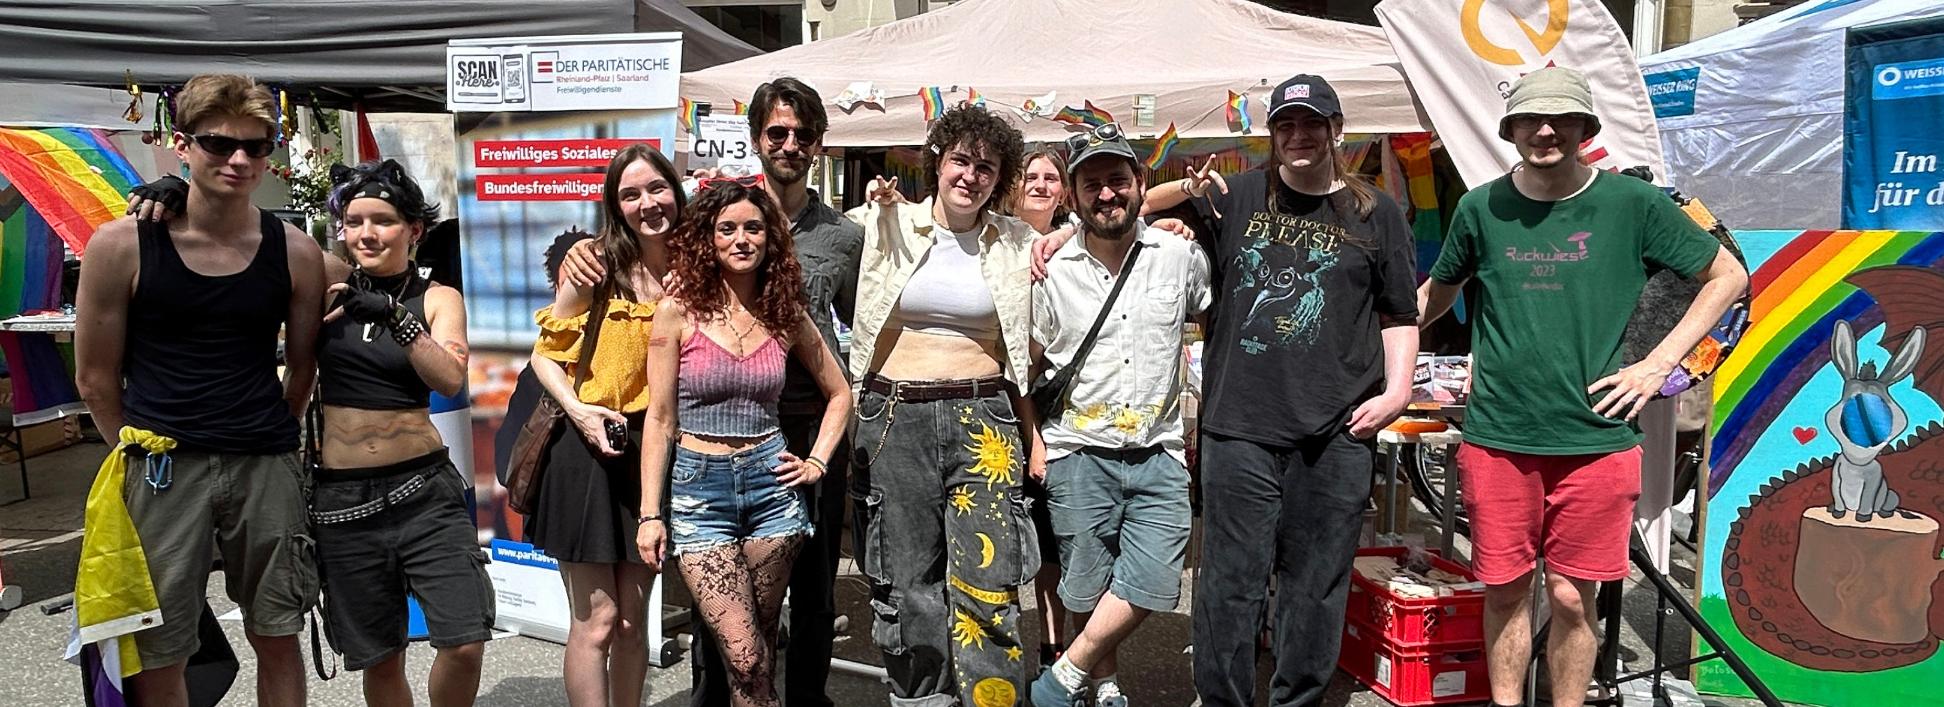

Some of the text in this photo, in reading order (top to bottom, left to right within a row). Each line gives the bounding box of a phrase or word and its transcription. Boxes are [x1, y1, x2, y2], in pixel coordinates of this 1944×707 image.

[457, 60, 497, 80] SCAN
[556, 57, 669, 73] DER PARITÄTISCHE
[461, 75, 495, 87] Here
[556, 74, 649, 83] Rheinland-Pfalz Saarland
[556, 85, 622, 95] Freiwilligendienste
[480, 145, 617, 163] Freiwilliges Soziales
[1889, 151, 1937, 174] Im
[1867, 182, 1920, 213] für
[1253, 211, 1346, 235] DOCTOR DOCTOR
[1243, 219, 1344, 254] PLEASE
[1529, 264, 1556, 277] 2023
